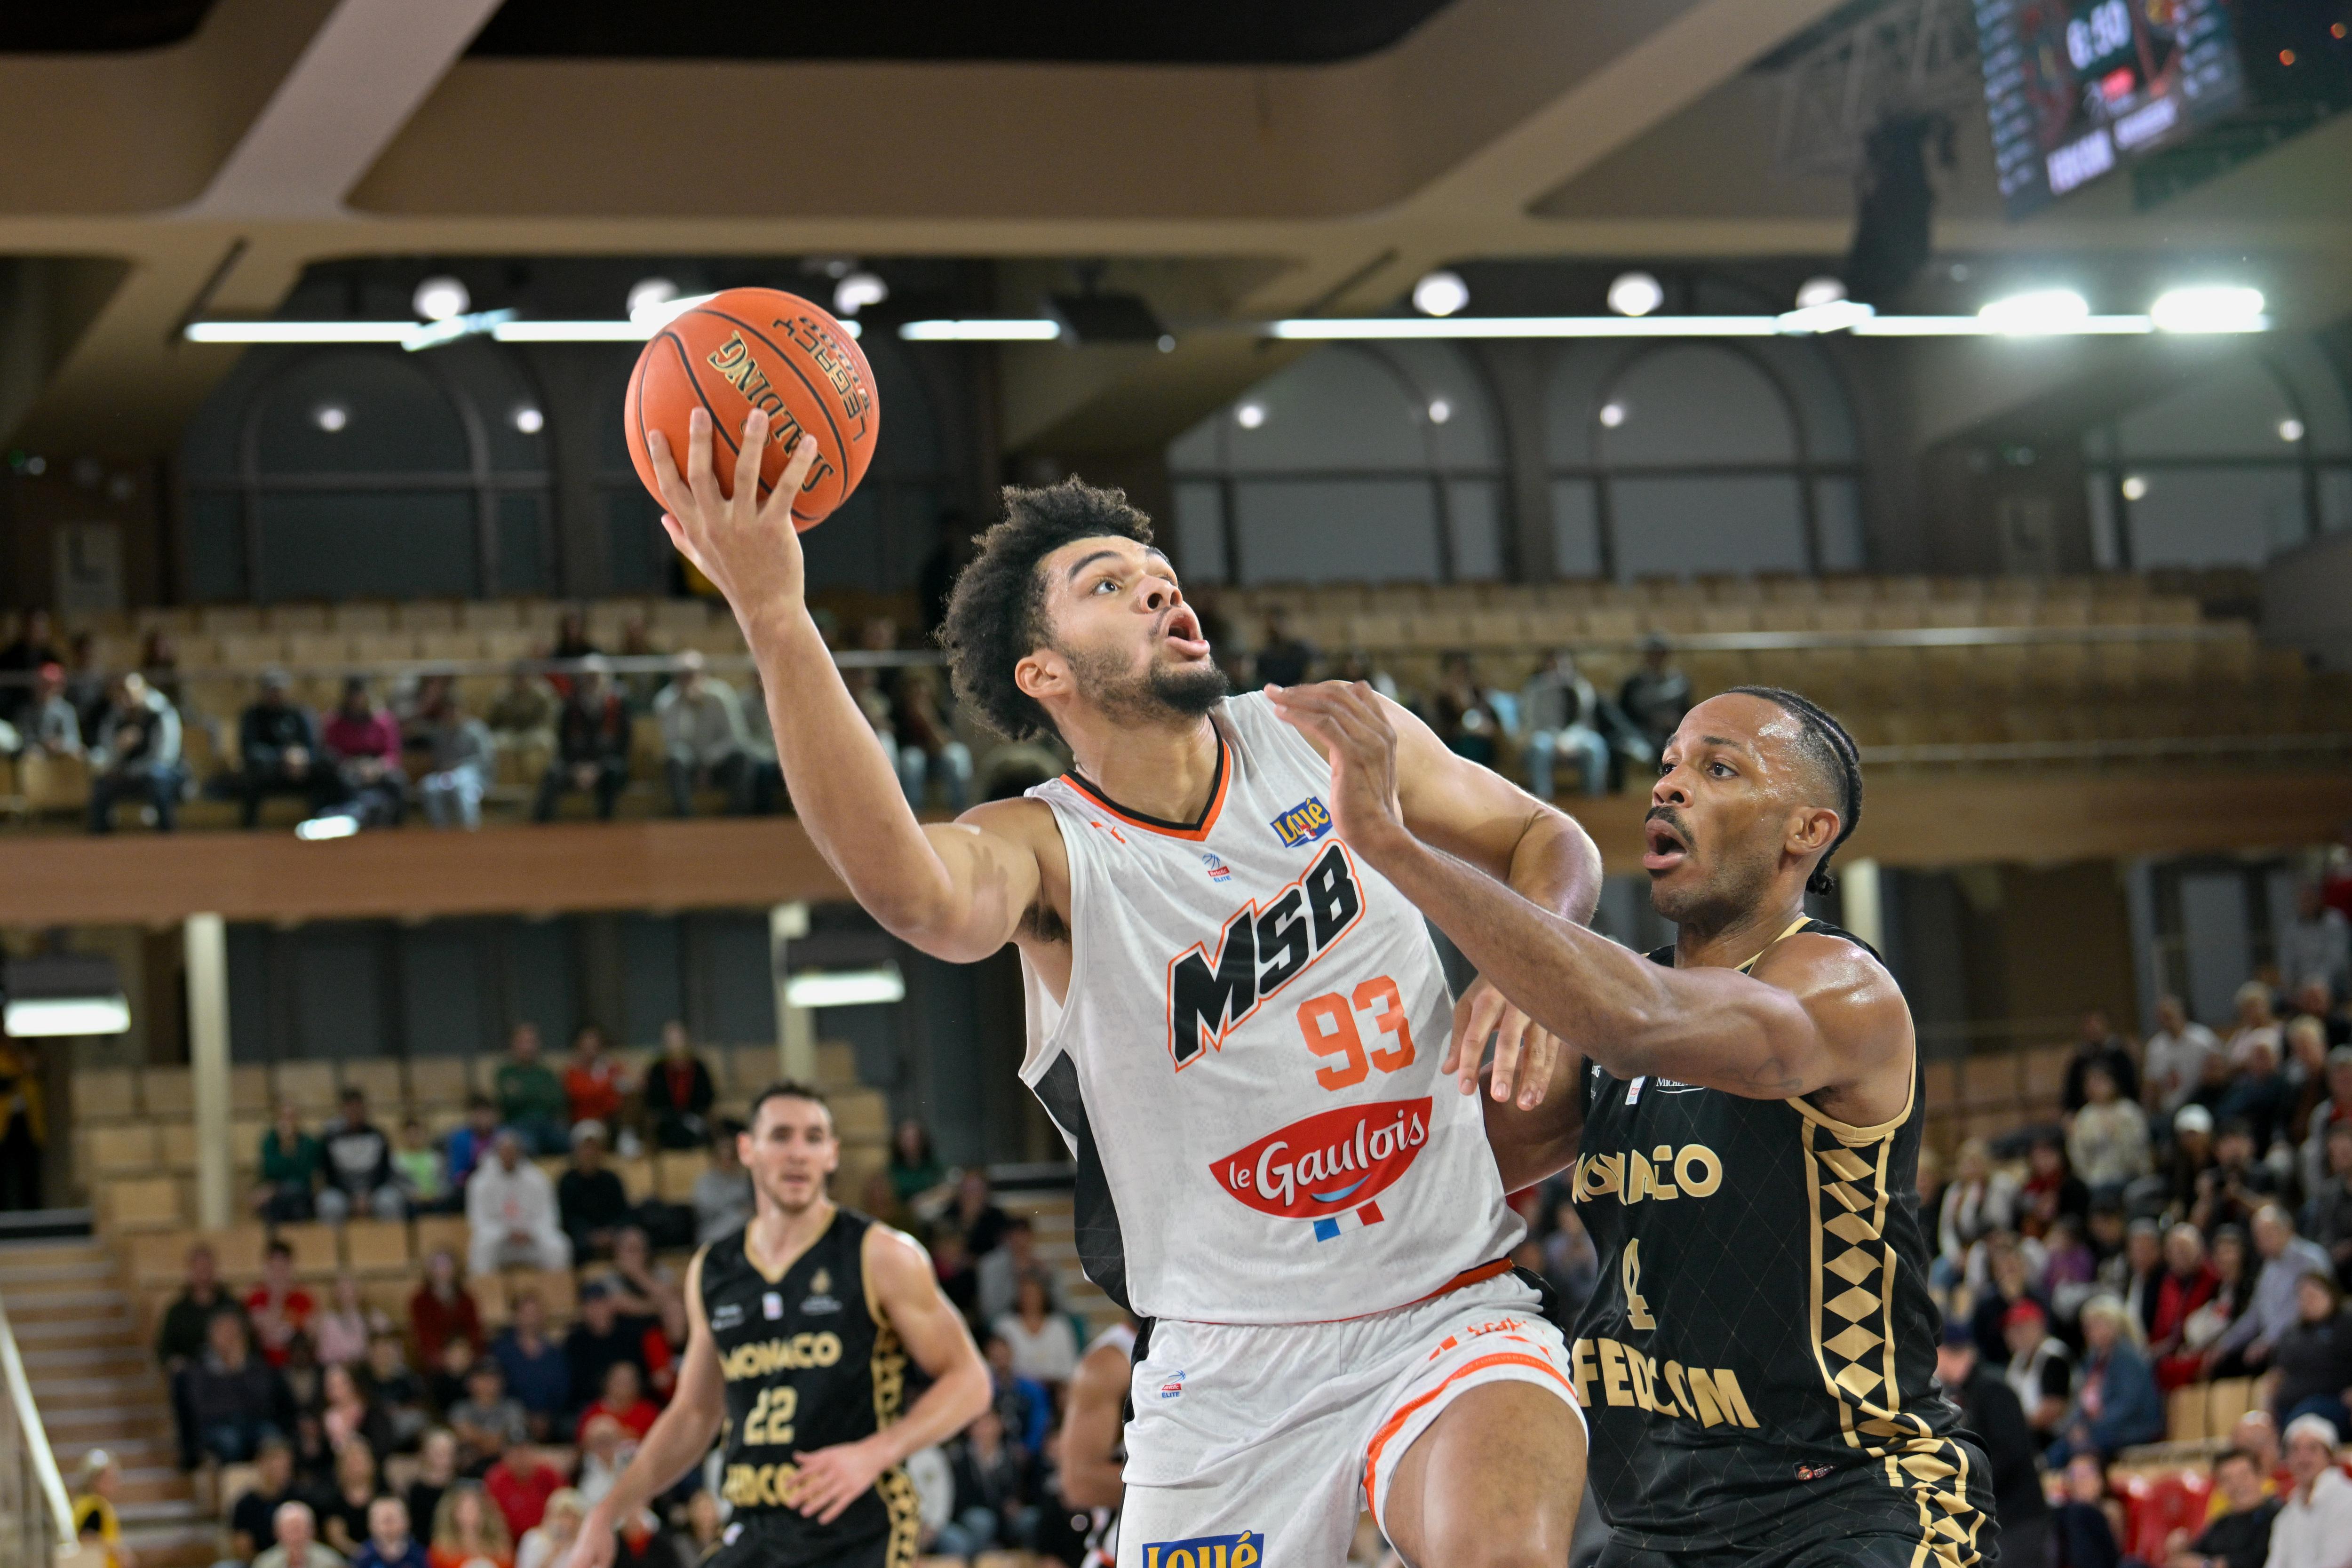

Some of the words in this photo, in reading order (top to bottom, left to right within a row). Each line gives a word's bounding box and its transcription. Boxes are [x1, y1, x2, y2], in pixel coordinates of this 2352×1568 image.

[707, 330, 835, 492] SALDING
[772, 319, 866, 442] LEGACY
[1273, 797, 1329, 844] Loué
[1171, 842, 1361, 1066] MSB
[1296, 974, 1416, 1091] 93
[1229, 1161, 1250, 1190] le
[1256, 1109, 1425, 1207] Gaulois
[1622, 1237, 1656, 1330] 4
[743, 1385, 799, 1446] 22
[1572, 1337, 1761, 1429] FEDCOM
